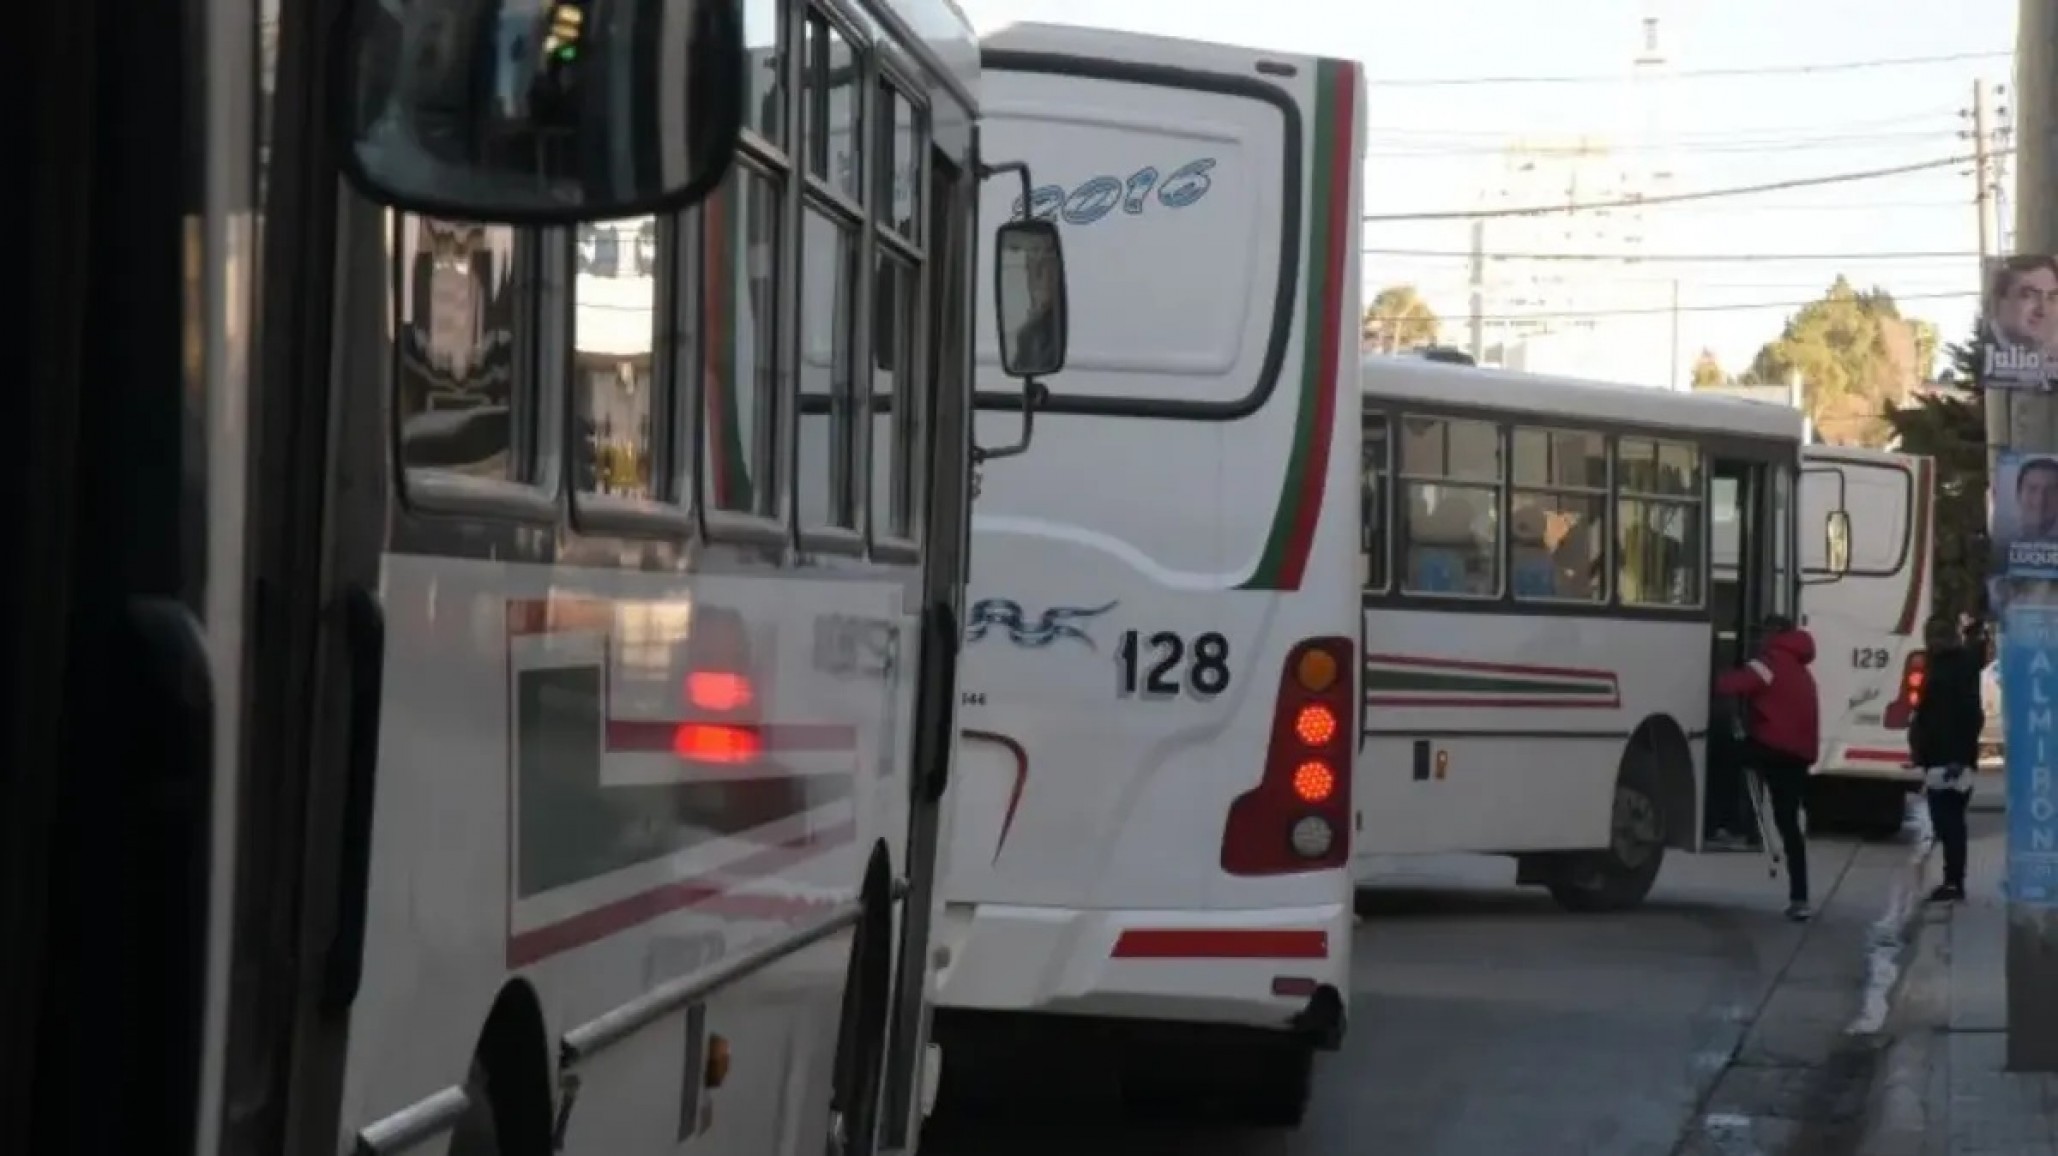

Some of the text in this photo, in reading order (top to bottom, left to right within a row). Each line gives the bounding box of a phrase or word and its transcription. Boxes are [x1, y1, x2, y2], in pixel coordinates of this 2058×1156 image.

[1011, 157, 1217, 226] 2016
[1984, 343, 2040, 376] Julio
[1117, 630, 1230, 697] 128
[1851, 647, 1889, 669] 129
